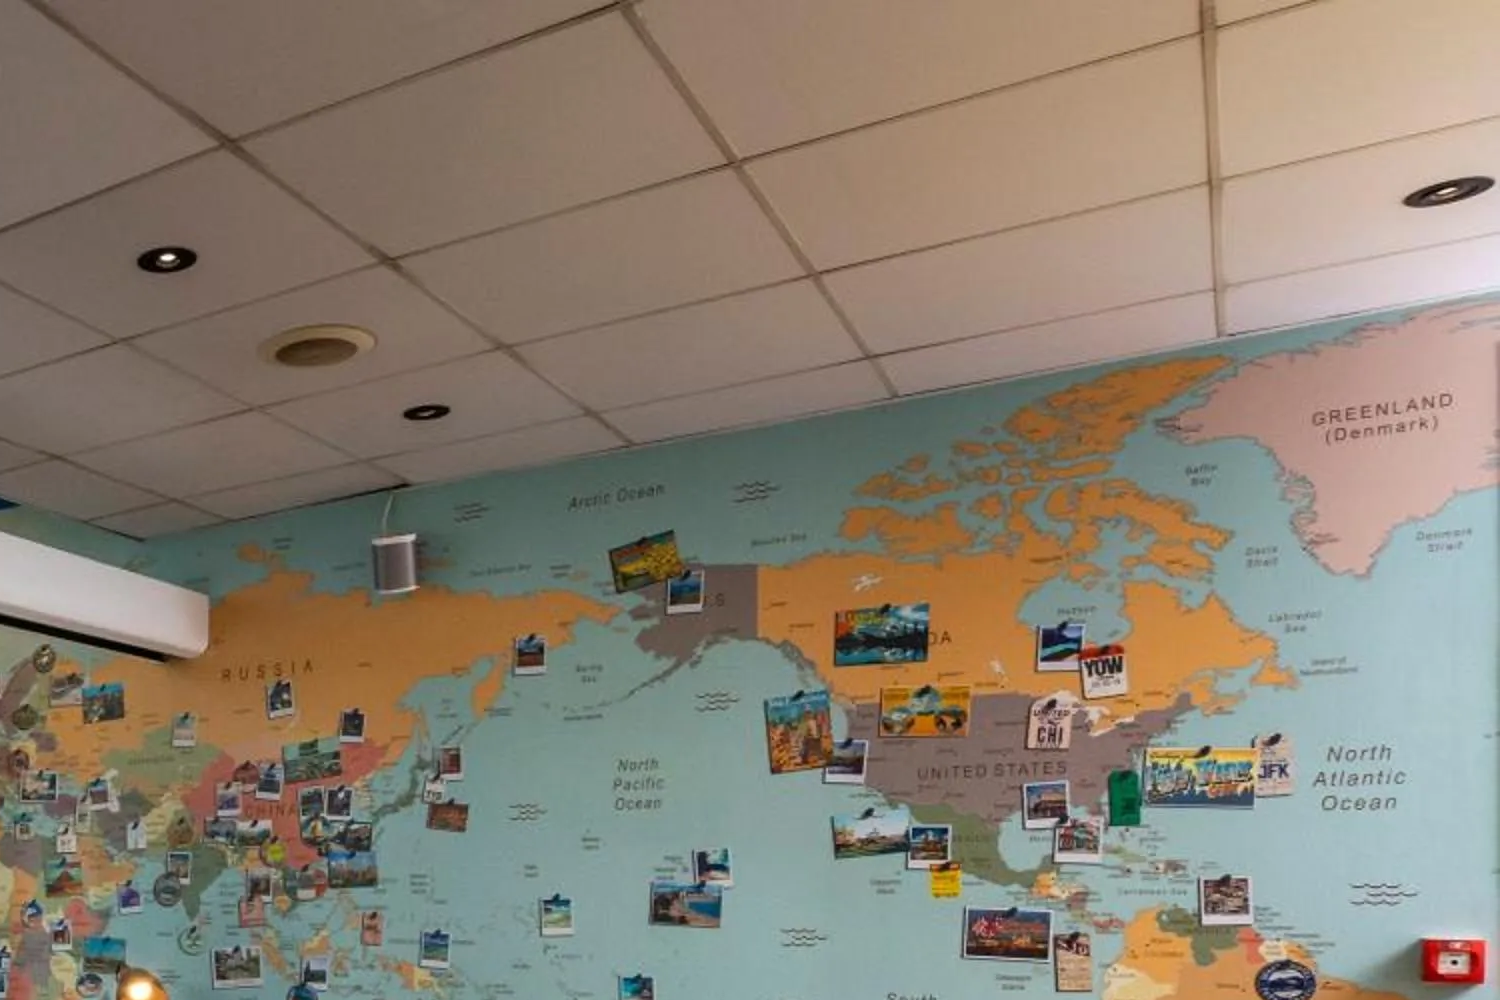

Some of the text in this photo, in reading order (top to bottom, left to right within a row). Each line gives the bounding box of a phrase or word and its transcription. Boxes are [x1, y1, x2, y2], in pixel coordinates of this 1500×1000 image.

[1311, 392, 1454, 427] GREENLAND
[1324, 416, 1441, 445] (Denmark)
[567, 483, 666, 512] Arctic Ocean
[221, 659, 315, 682] RUSSIA
[1084, 655, 1124, 679] YOW
[1037, 726, 1063, 743] CHI
[1327, 743, 1393, 763] North
[616, 757, 660, 773] North
[917, 760, 1068, 781] UNITED STATES
[1257, 763, 1290, 780] JFK
[612, 775, 666, 792] Pacific
[1311, 768, 1407, 789] Atlantic
[246, 801, 296, 817] CHINA
[613, 795, 663, 811] Ocean
[1320, 795, 1398, 812] Ocean
